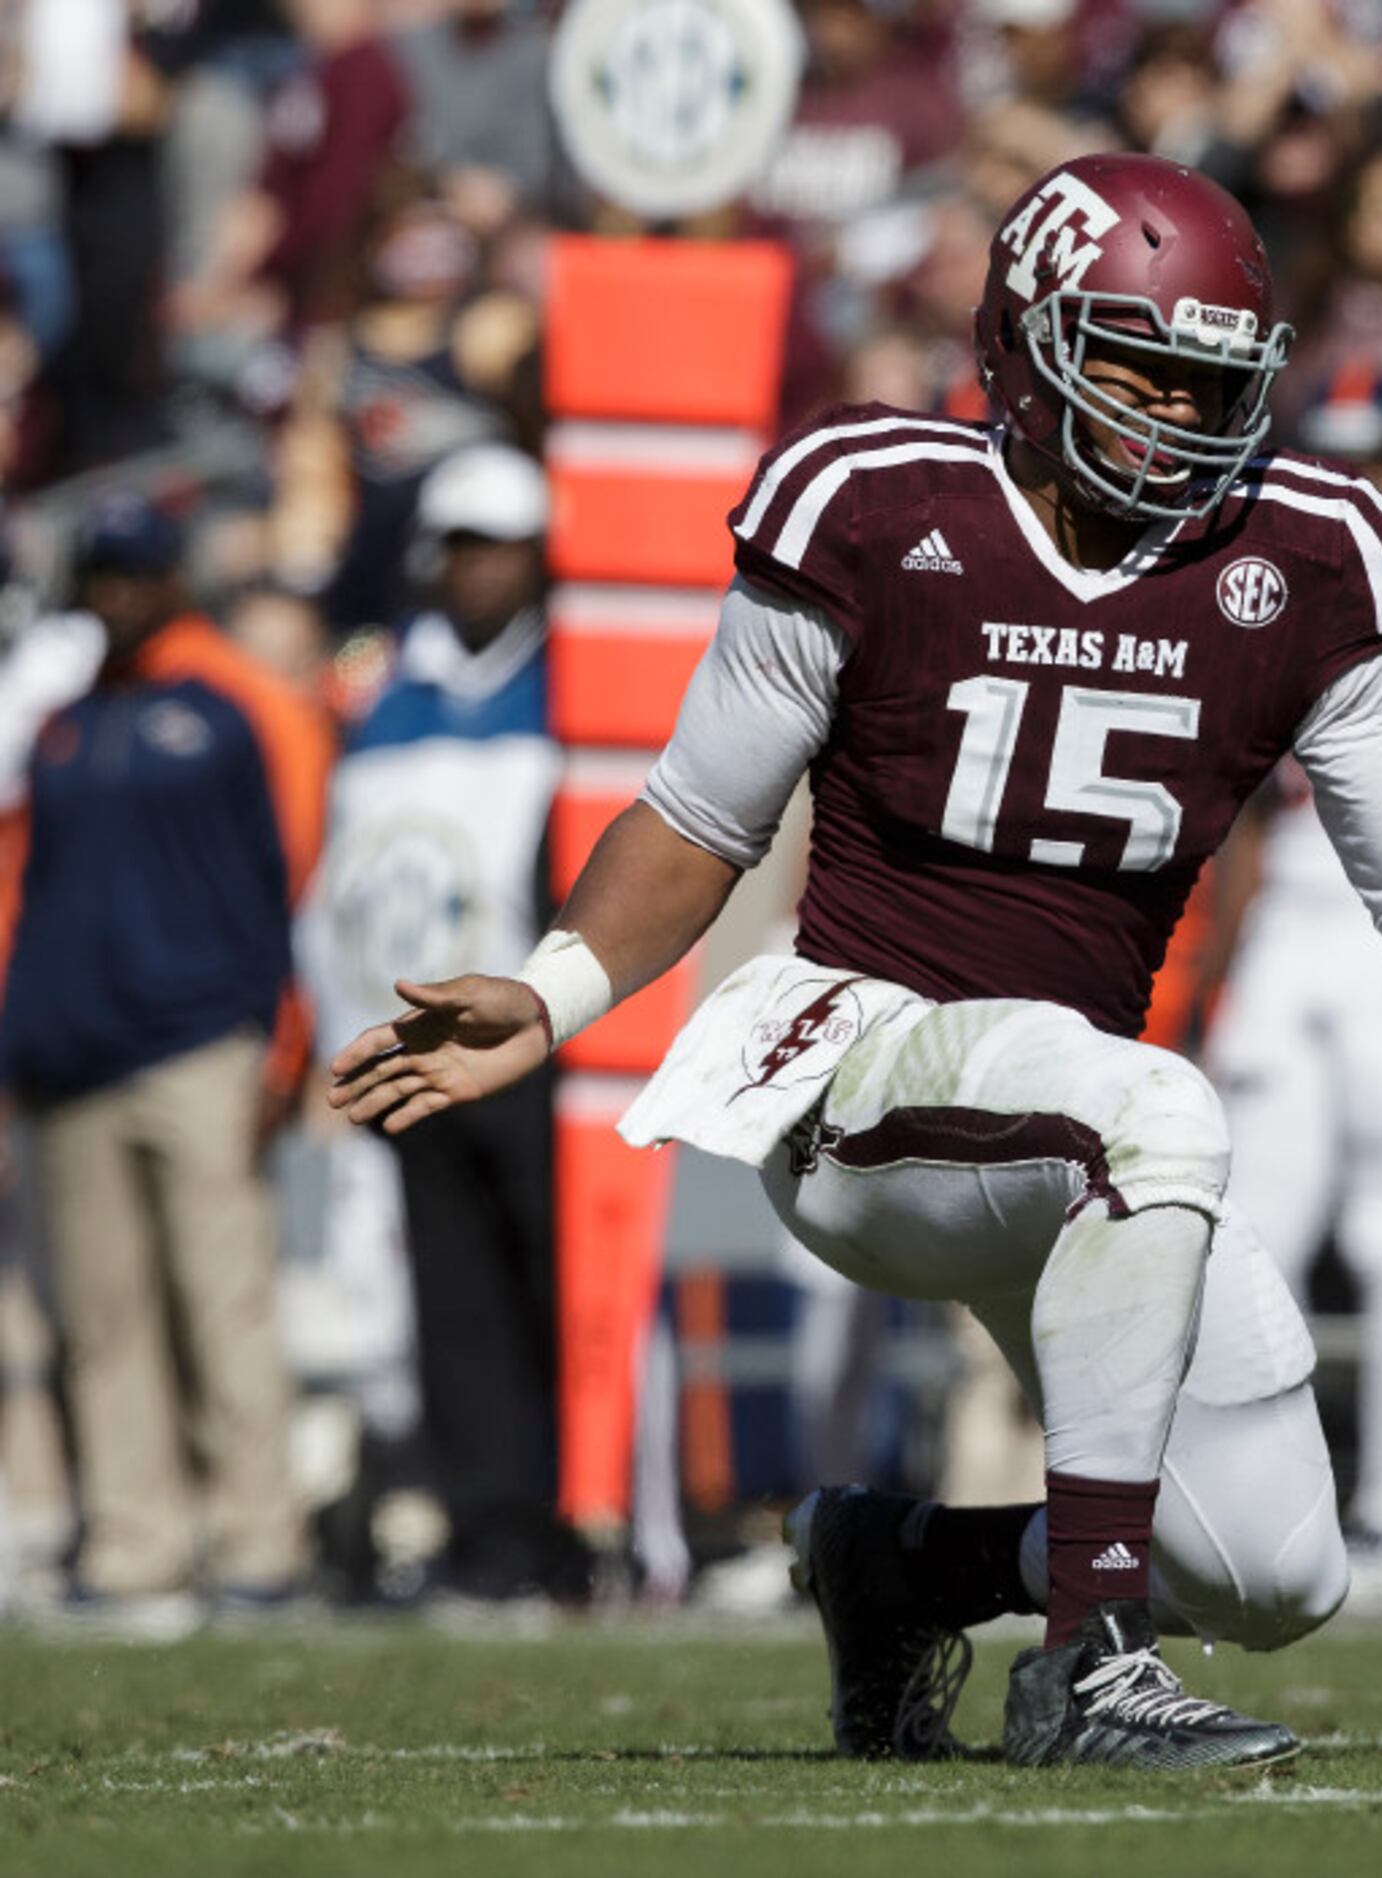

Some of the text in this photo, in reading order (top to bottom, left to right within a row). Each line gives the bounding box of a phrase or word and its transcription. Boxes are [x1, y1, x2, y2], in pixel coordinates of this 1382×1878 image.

[1224, 562, 1280, 621] SEC
[981, 621, 1189, 679] TEXAS A&M
[941, 674, 1202, 873] 15
